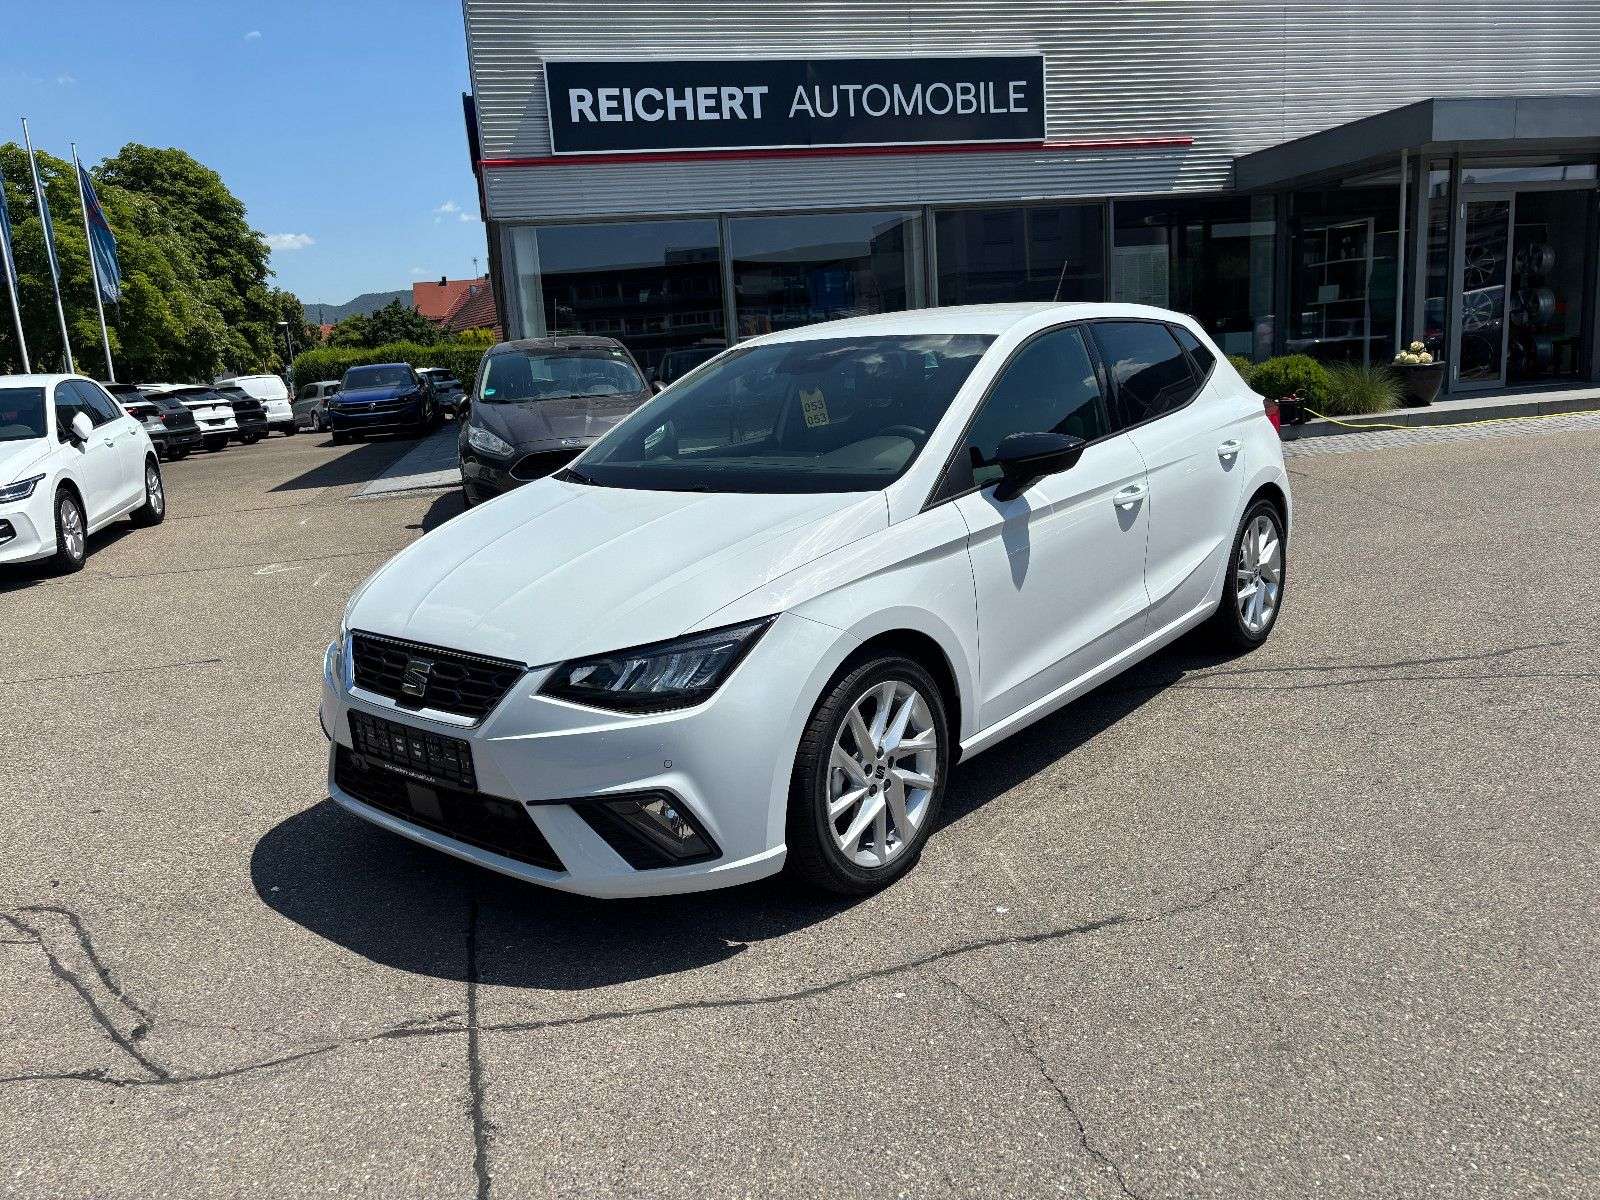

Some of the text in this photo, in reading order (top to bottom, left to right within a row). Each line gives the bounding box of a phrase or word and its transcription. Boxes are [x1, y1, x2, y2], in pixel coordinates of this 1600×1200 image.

[568, 80, 1028, 123] REICHERT AUTOMOBILE
[804, 400, 824, 412] 053
